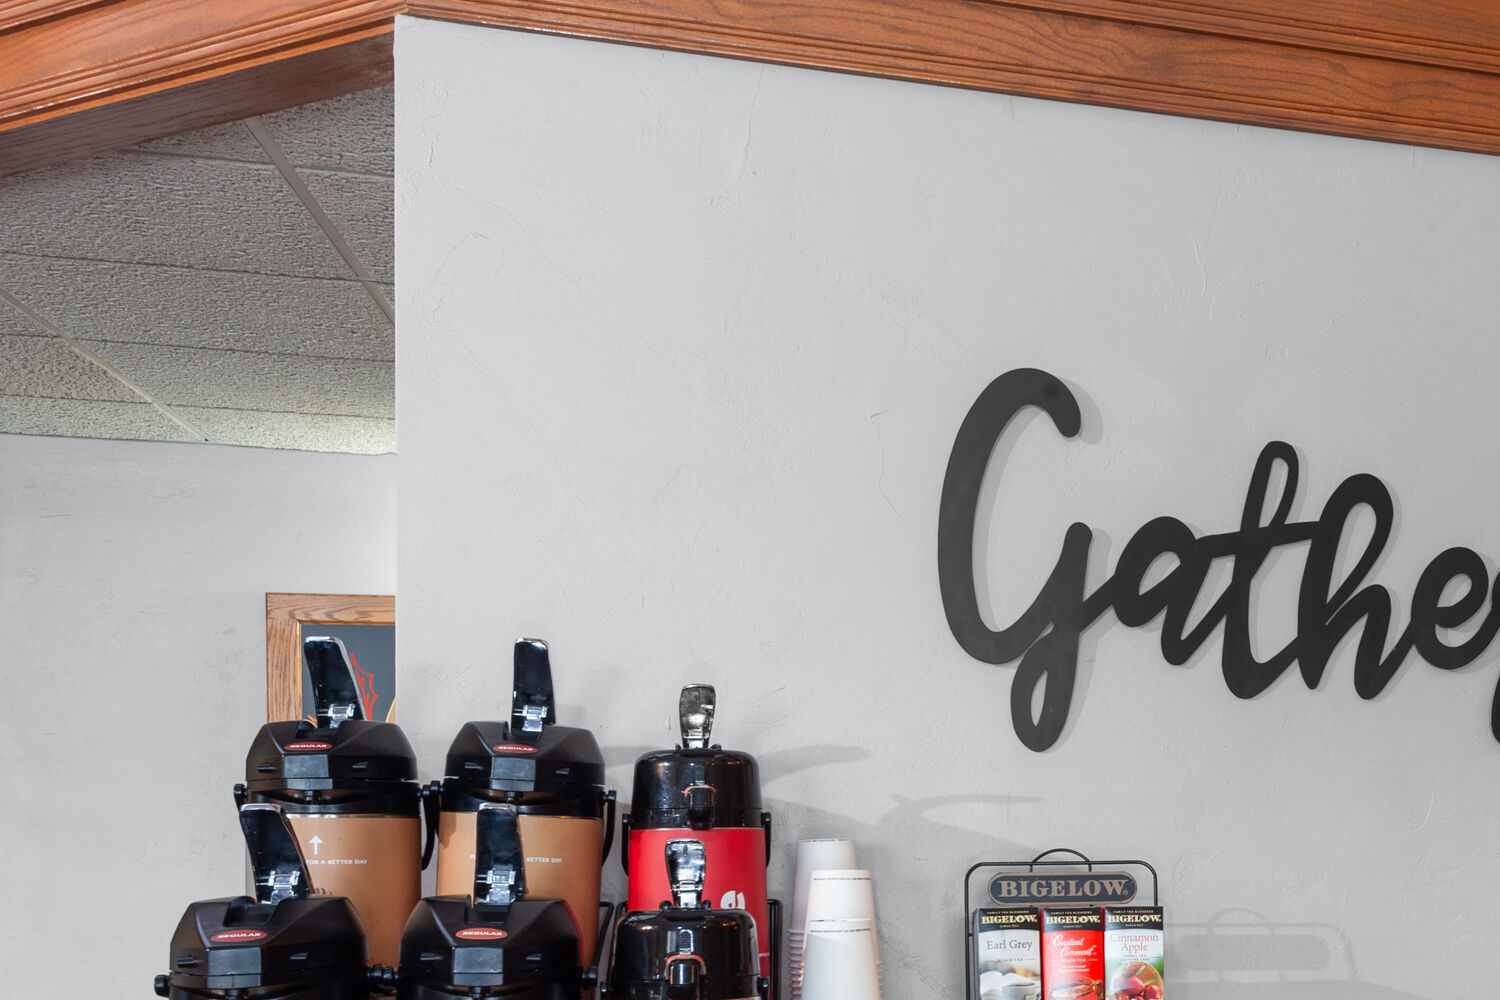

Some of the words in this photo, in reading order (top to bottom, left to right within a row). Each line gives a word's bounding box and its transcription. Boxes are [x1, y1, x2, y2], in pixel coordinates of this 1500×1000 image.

[998, 879, 1129, 898] BIGELOW
[217, 931, 262, 940] REGULAR
[1109, 932, 1159, 943] Cinnamon
[987, 939, 1007, 950] Earl
[1009, 939, 1033, 951] Grey
[1121, 941, 1149, 953] Apple
